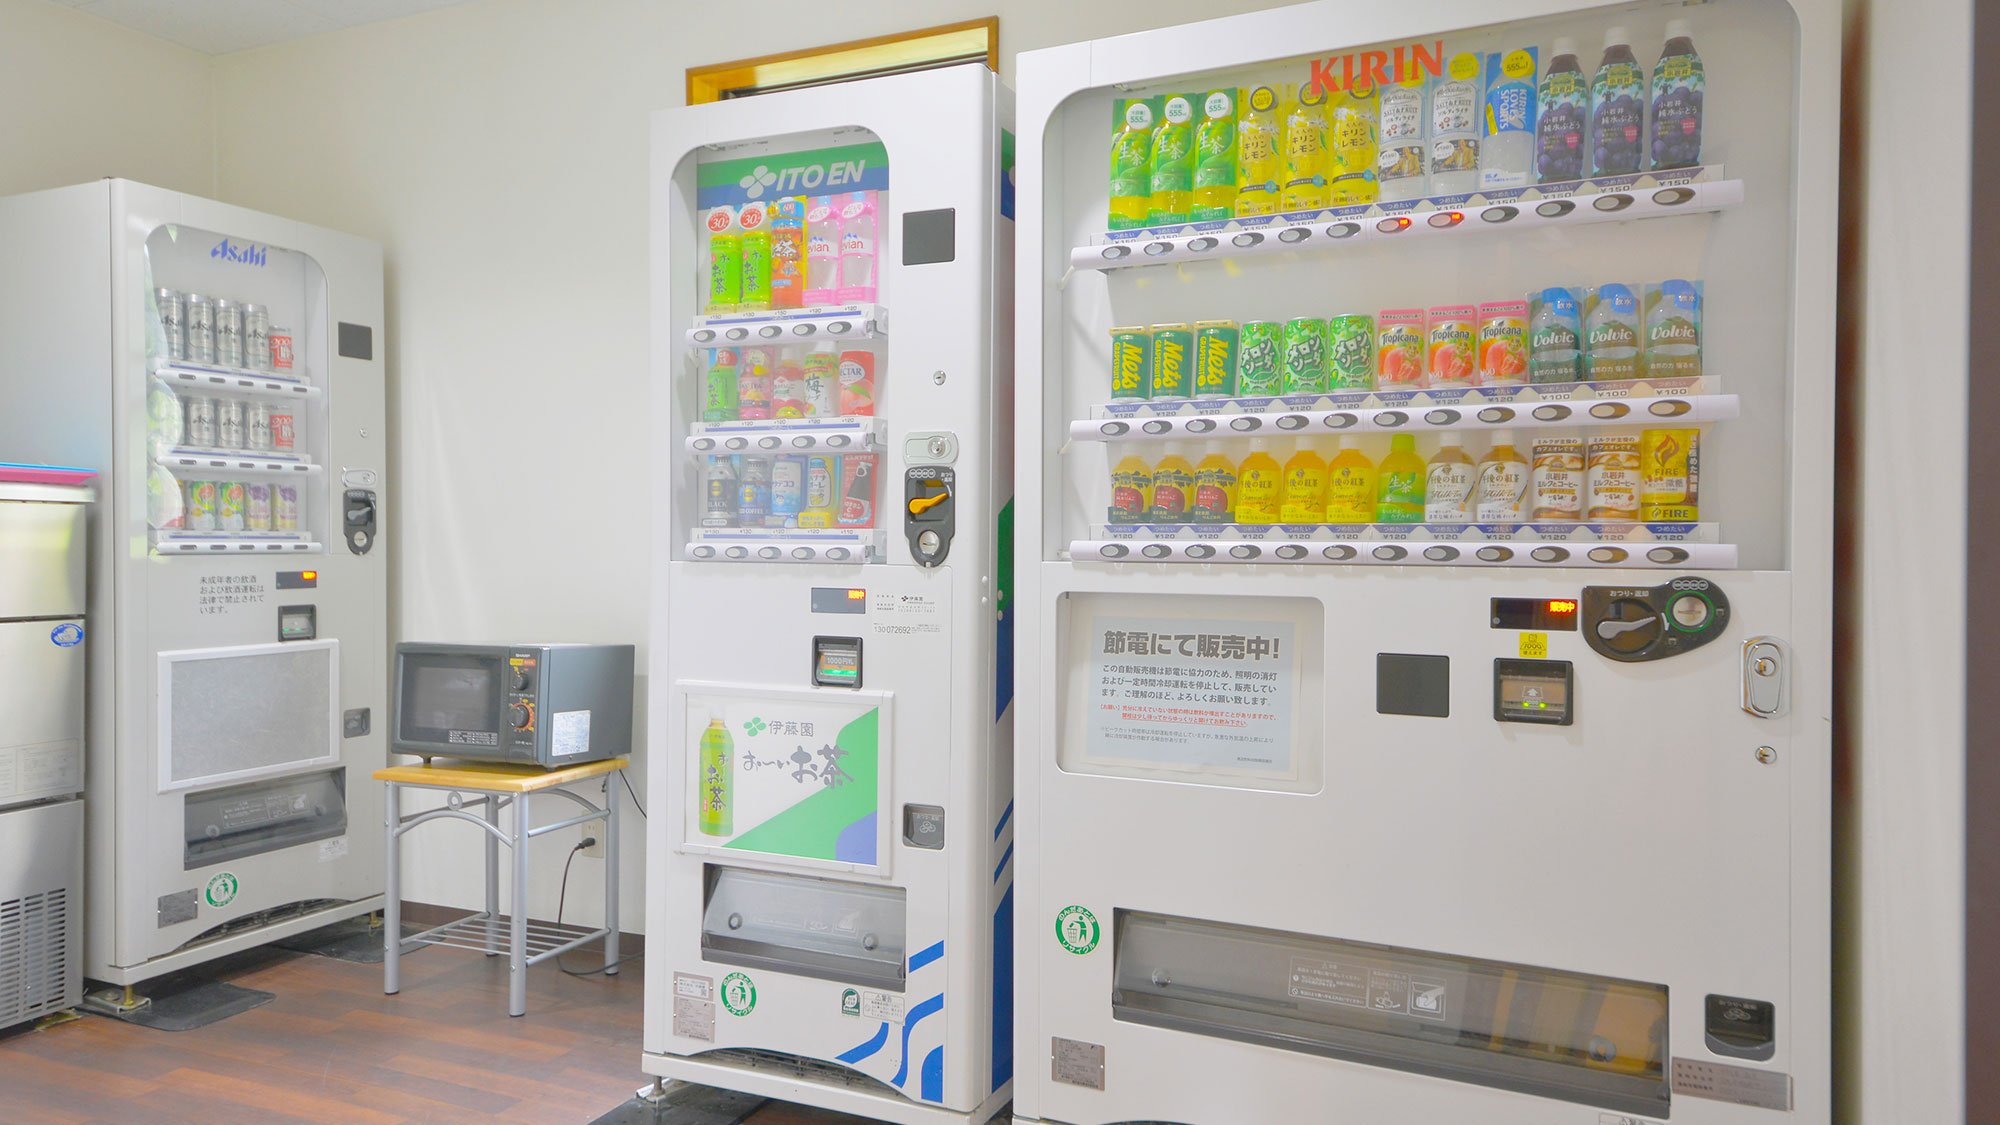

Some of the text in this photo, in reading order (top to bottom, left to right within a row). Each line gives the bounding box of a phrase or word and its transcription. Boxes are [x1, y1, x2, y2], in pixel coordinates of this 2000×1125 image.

[1310, 40, 1444, 96] KIRIN
[1499, 89, 1510, 130] SPORTS
[1509, 88, 1519, 121] LOVES
[1519, 88, 1528, 121] KIRIN
[1658, 100, 1681, 109] 小岩井
[1601, 107, 1624, 117] 小岩井
[1658, 106, 1698, 118] 純水ぶどう
[1543, 115, 1566, 124] 小岩井
[1601, 114, 1640, 126] 純水ぶどう
[1342, 128, 1367, 137] キリン
[1543, 121, 1581, 133] 純水ぶどう
[1199, 130, 1225, 156] 生茶
[1292, 134, 1316, 144] キリン
[1341, 138, 1367, 148] レモン
[1157, 134, 1185, 161] 生茶
[1244, 141, 1267, 150] キリン
[1292, 145, 1316, 154] レモン
[1118, 140, 1146, 167] 生茶
[1244, 150, 1267, 160] レモン
[775, 159, 866, 192] ITO EN
[210, 237, 267, 268] Asahi
[1381, 332, 1419, 345] Tropicana
[1431, 328, 1470, 342] Tropicana
[1481, 325, 1522, 340] Tropicana
[1589, 328, 1633, 345] Volvic
[1651, 325, 1695, 340] Volvic
[1533, 332, 1575, 348] Volvic
[1121, 341, 1143, 389] Mets
[1162, 338, 1184, 388] Mets
[1206, 335, 1229, 385] Mets
[839, 367, 863, 376] ECTAR
[805, 372, 825, 395] 梅
[1541, 393, 1571, 401] ¥100
[1597, 390, 1628, 398] ¥100
[1655, 388, 1687, 396] ¥100
[1384, 400, 1409, 408] ¥120
[1487, 395, 1514, 403] ¥120
[1545, 472, 1569, 481] 小岩井
[1601, 471, 1625, 480] 小岩井
[1654, 467, 1679, 476] FIRE
[1288, 478, 1318, 487] 後の紅茶
[1389, 475, 1413, 494] 生茶
[1537, 480, 1579, 488] ミルクとコーヒー
[1593, 479, 1636, 487] ミルクとコーヒー
[1430, 488, 1450, 498] Milk
[1483, 488, 1505, 498] Milk
[1663, 509, 1689, 518] FIRE
[199, 575, 257, 585] 未成年者の飲酒
[199, 584, 265, 595] および飲酒運転は
[199, 594, 265, 605] 法律で禁止されて
[199, 605, 229, 615] います。
[1103, 629, 1280, 661] 節電にて販売中!
[1102, 664, 1278, 682] この自動販売機は節電に協力のため、照明の消灯
[1101, 676, 1277, 694] および一定時間冷却運転を停止して、販売してい
[768, 720, 815, 737] 伊藤園
[1058, 905, 1097, 924] のんだあとは
[1062, 940, 1096, 955] リサイクル
